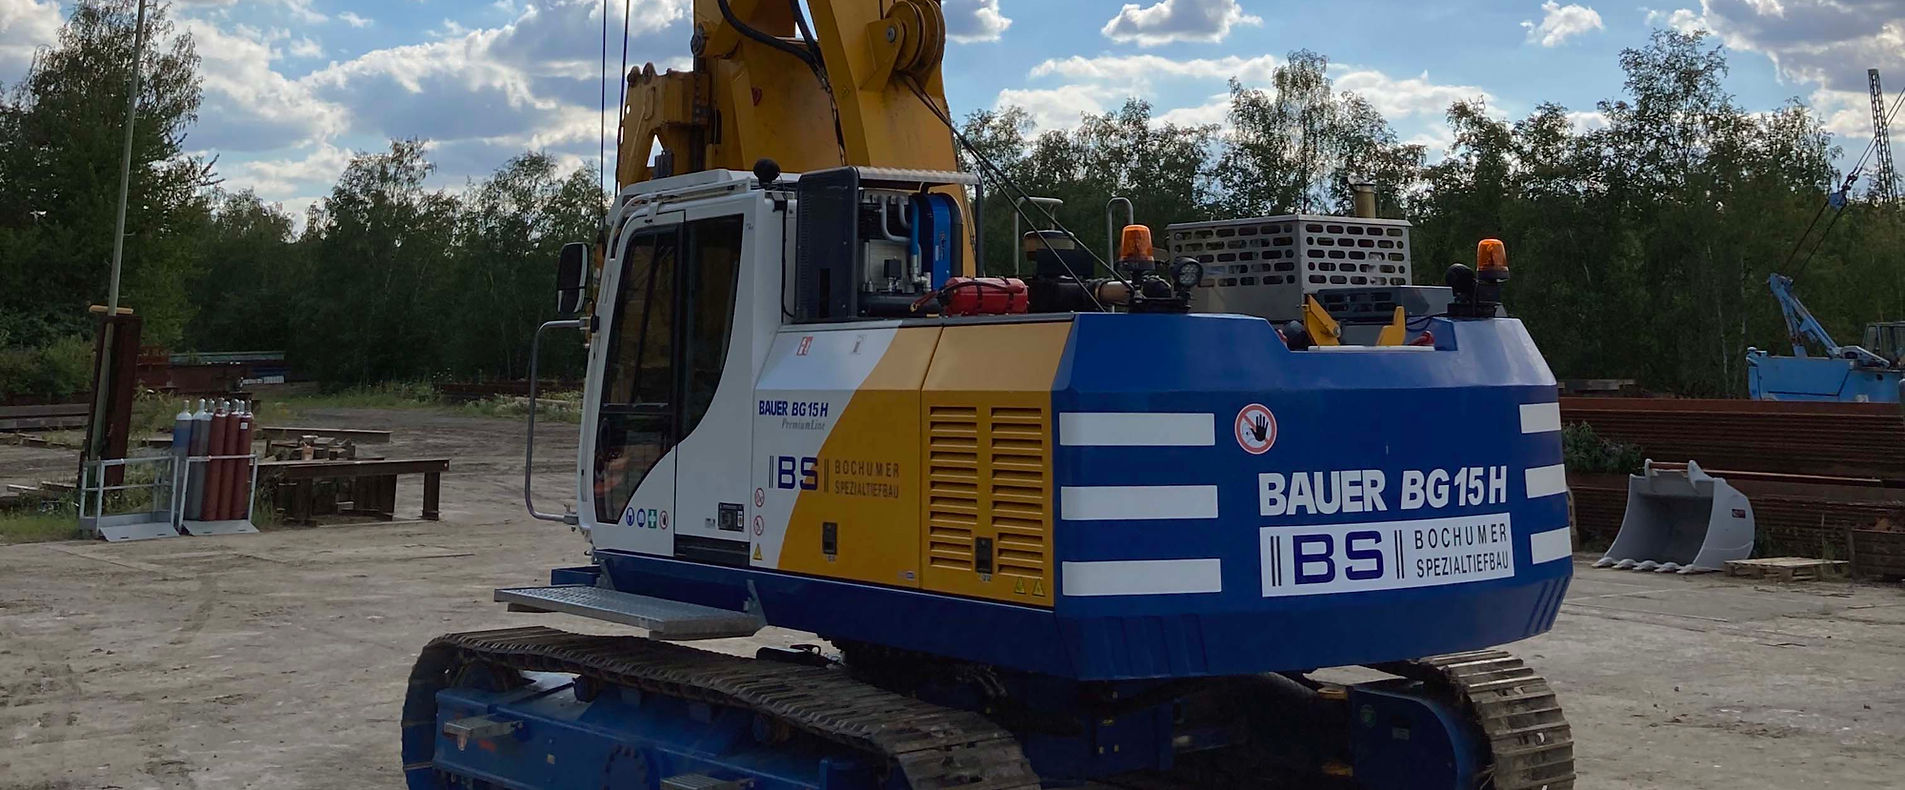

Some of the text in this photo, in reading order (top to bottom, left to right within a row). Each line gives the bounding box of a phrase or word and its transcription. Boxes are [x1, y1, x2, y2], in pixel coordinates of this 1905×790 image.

[759, 400, 788, 416] BAUER
[777, 456, 819, 491] BS
[834, 460, 900, 478] BOCHUMER
[834, 481, 900, 499] SPEZIALTIEFBAU
[1258, 469, 1388, 517] BAUER
[1414, 522, 1508, 550] BOCHUMER
[1292, 530, 1384, 586] BS
[1416, 550, 1509, 578] SPEZIALTIEFBAU
